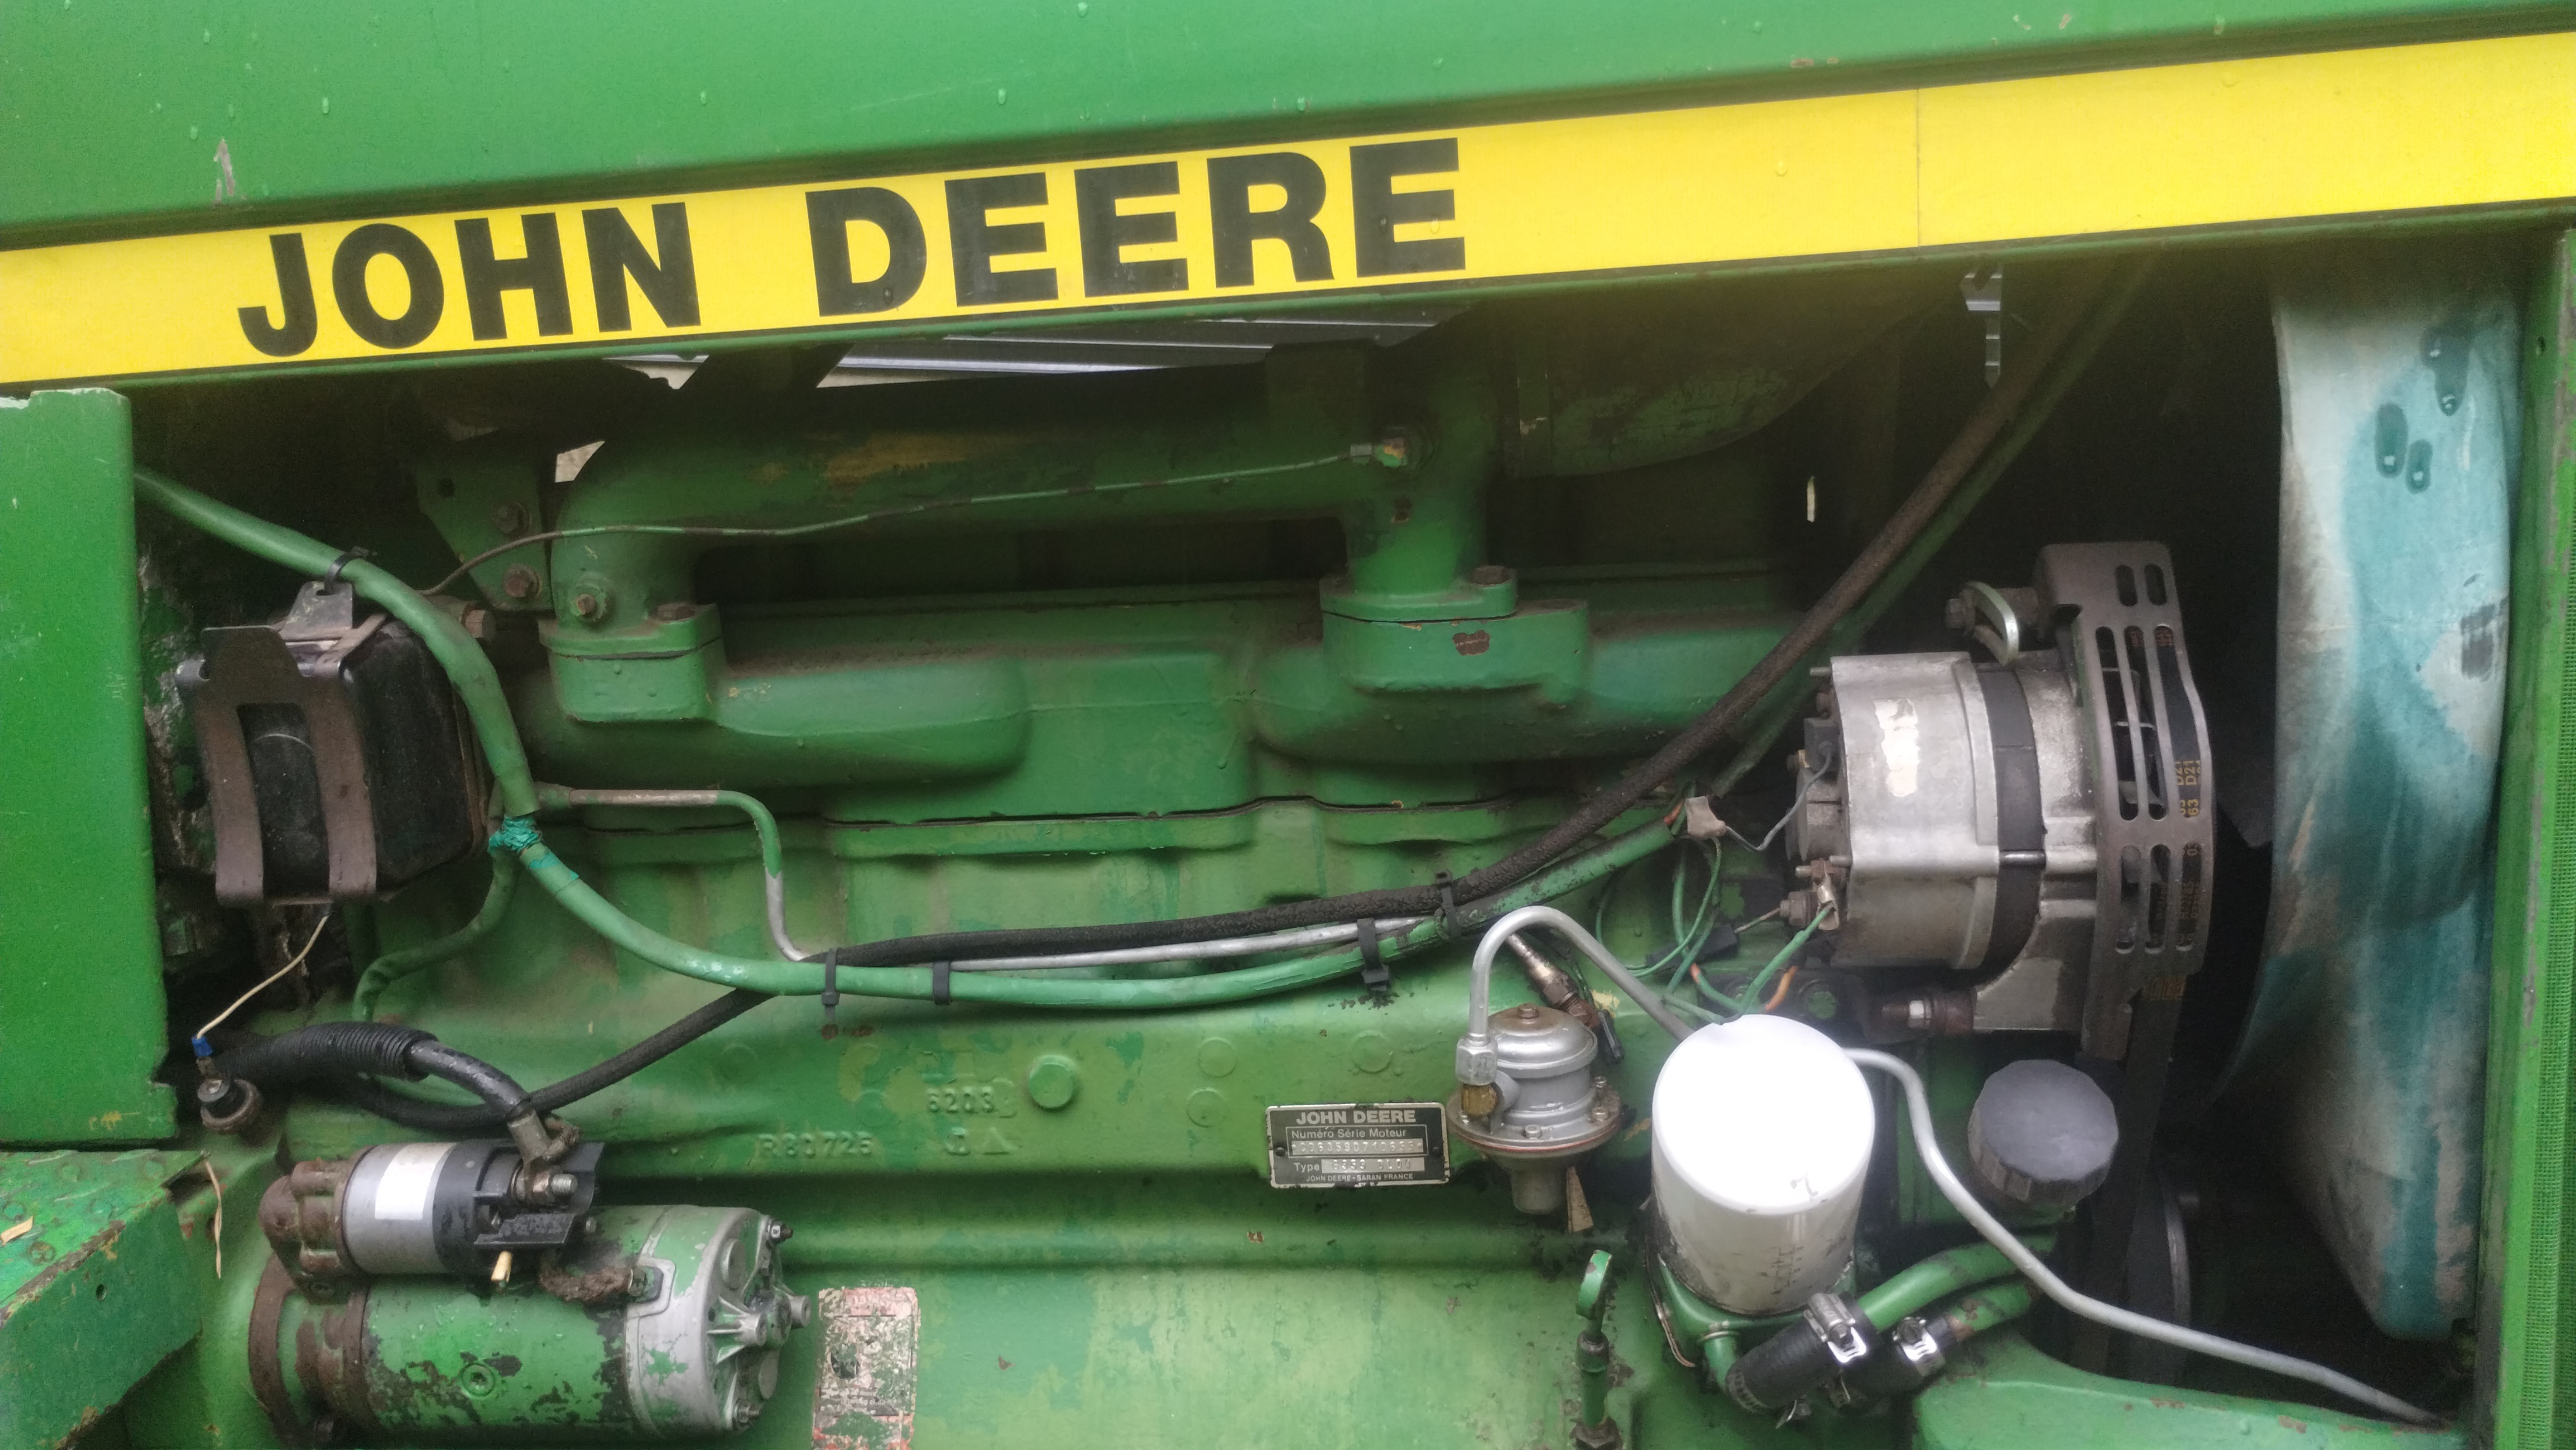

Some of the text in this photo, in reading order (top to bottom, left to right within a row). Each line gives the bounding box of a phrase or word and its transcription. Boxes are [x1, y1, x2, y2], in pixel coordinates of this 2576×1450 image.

[237, 138, 1466, 357] JOHN DEERE
[1296, 1110, 1416, 1124] JOHN DEERE
[1291, 1128, 1407, 1139] Numéro Série Moteur
[1294, 1162, 1320, 1173] Type
